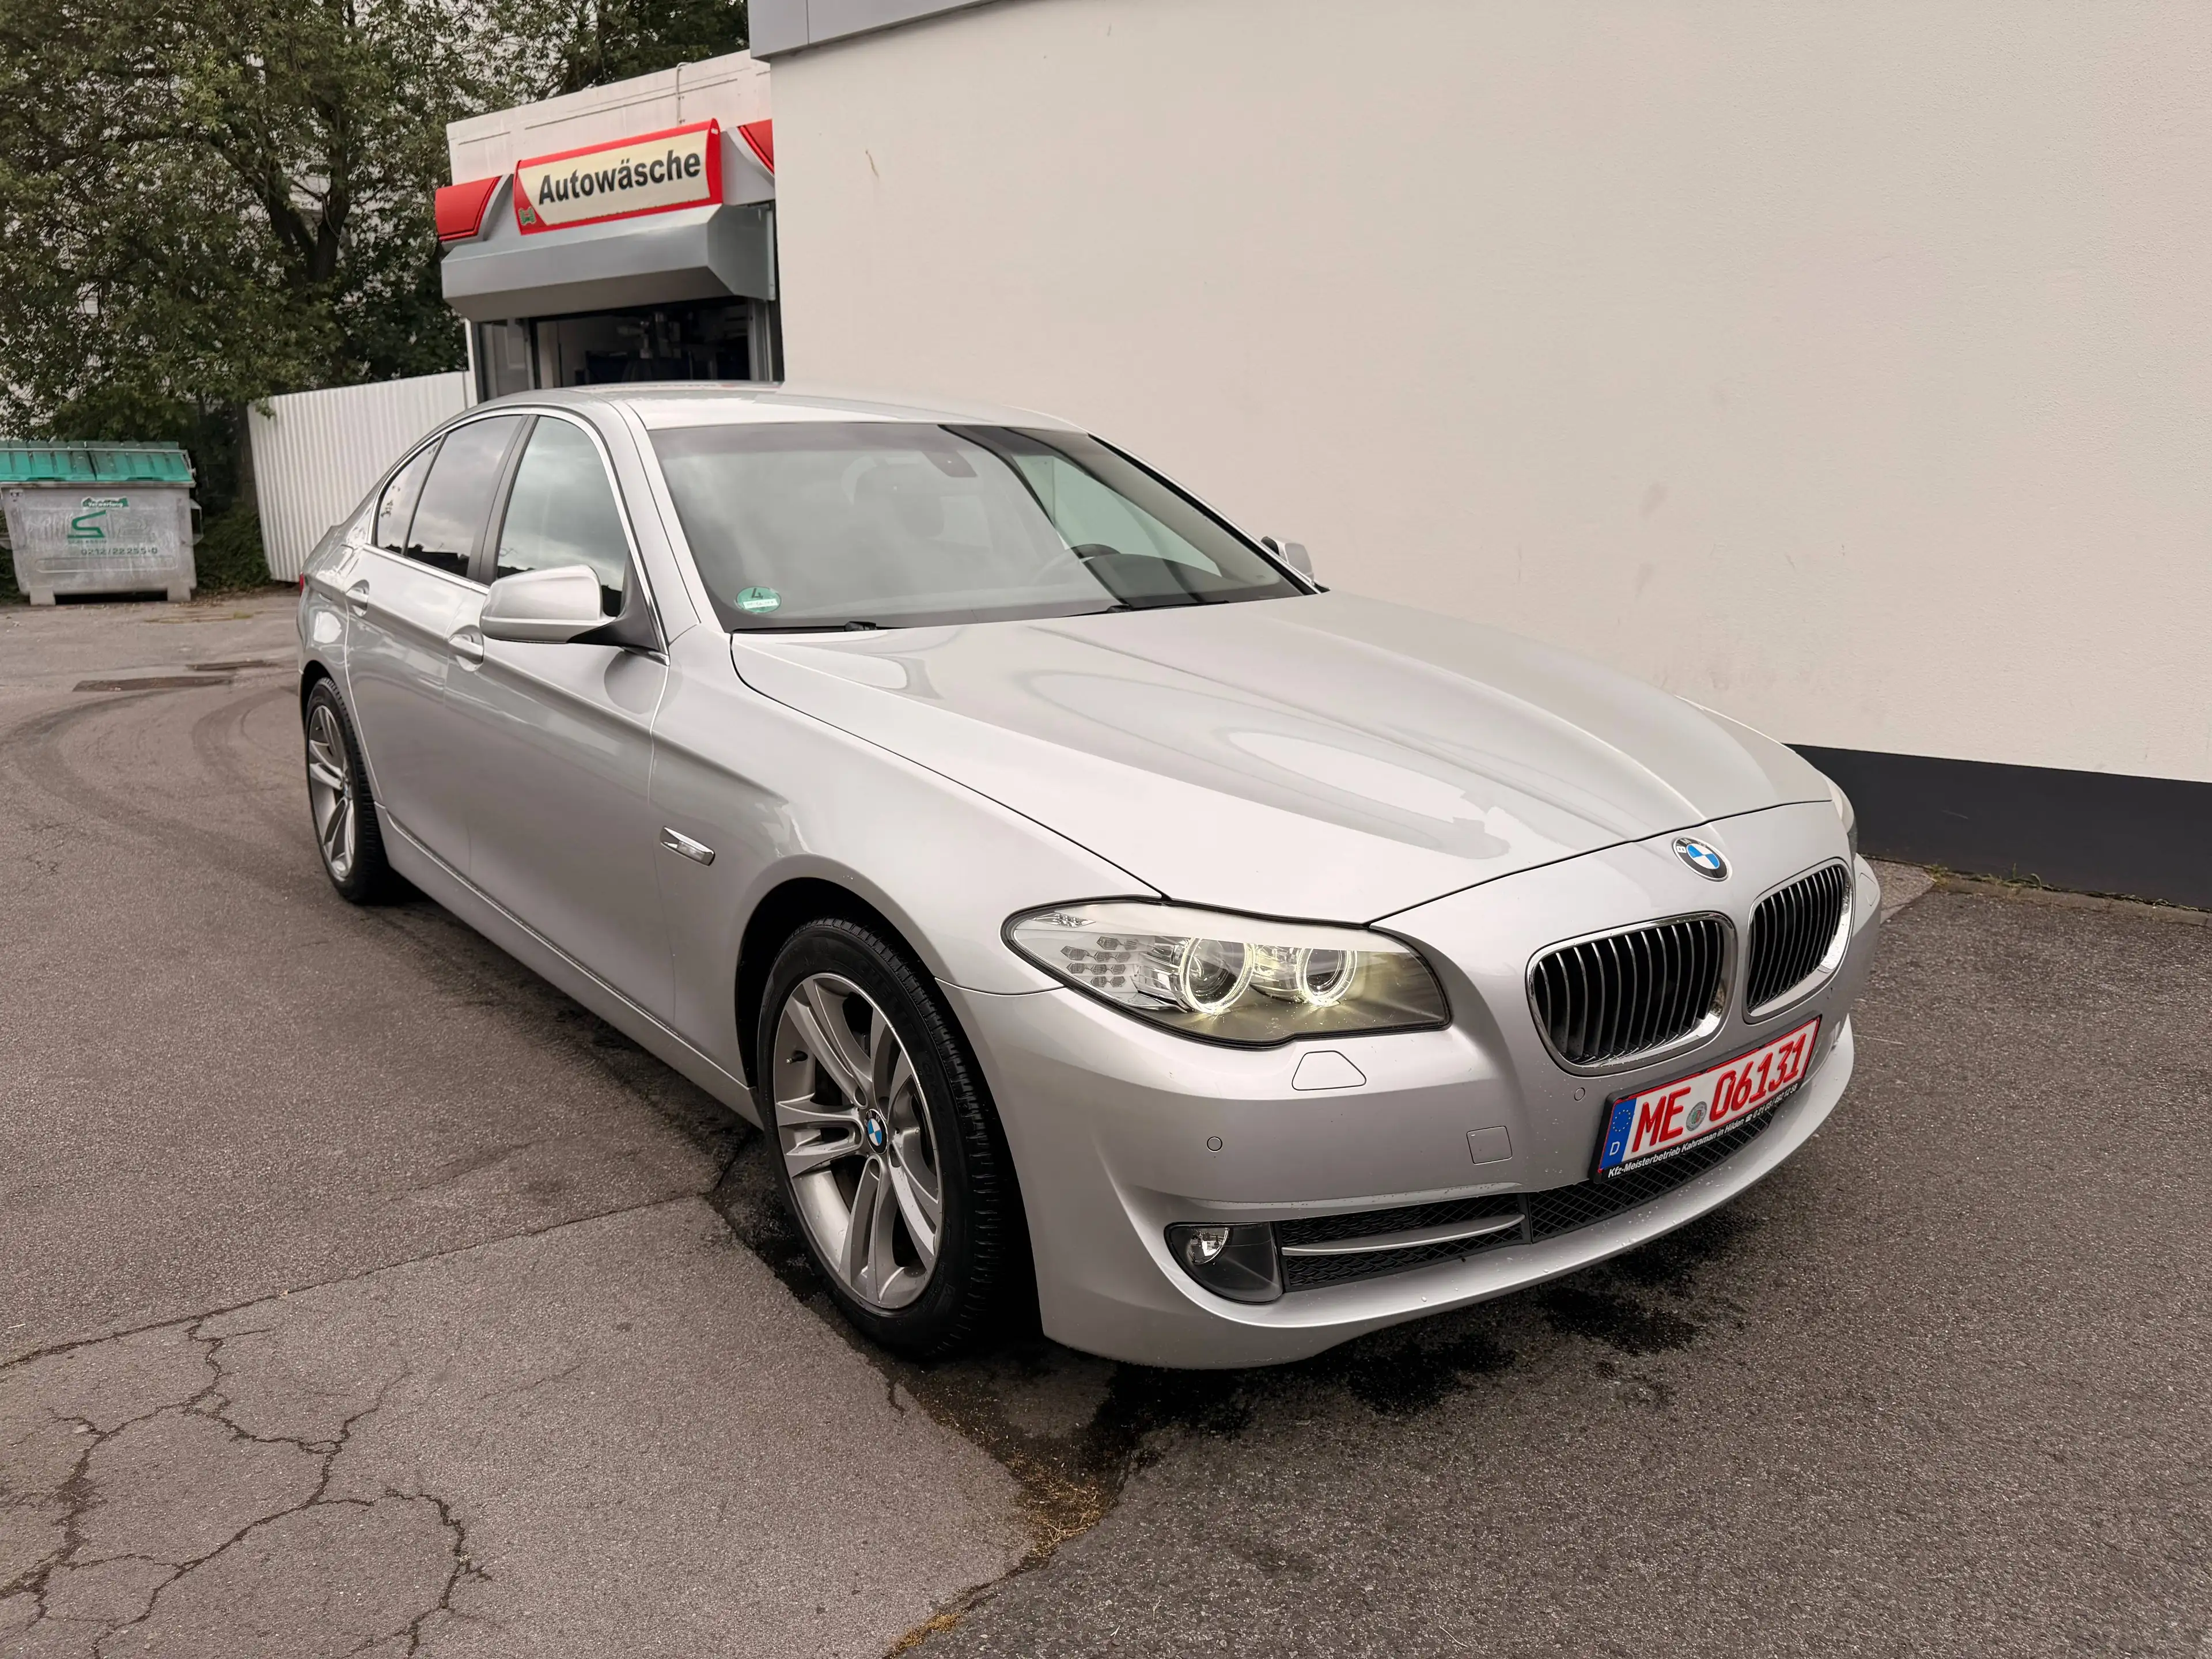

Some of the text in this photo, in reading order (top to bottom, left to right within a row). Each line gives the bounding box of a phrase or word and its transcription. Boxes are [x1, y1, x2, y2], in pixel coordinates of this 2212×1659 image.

[539, 149, 700, 206] Autowäsche
[751, 588, 763, 599] 4
[1609, 1033, 1807, 1156] D ME 06131
[1608, 1146, 1681, 1179] Kfz-Meisterbetrieb
[1681, 1132, 1717, 1153] Kahraman
[1717, 1128, 1724, 1138] in
[1724, 1119, 1745, 1134] Hilden
